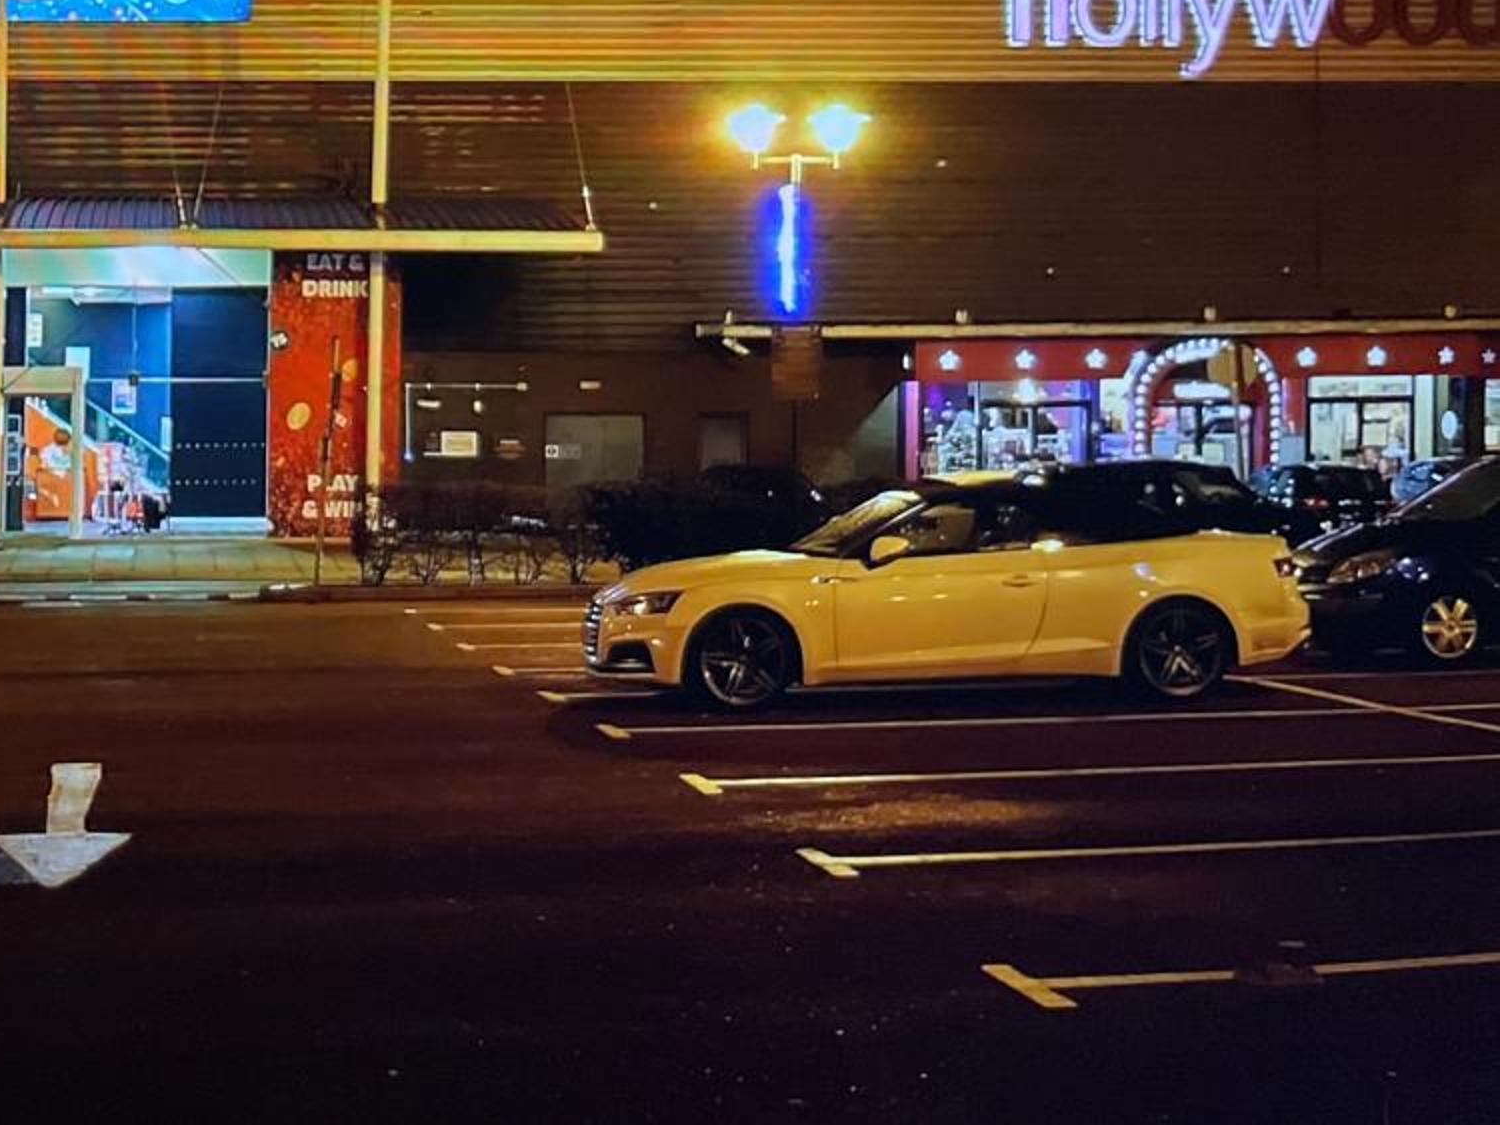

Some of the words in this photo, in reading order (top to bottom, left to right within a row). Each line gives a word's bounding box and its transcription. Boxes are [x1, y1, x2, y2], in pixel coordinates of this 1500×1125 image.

[306, 253, 345, 271] EAT
[347, 254, 365, 271] &
[301, 279, 369, 298] DRINK
[301, 500, 319, 519] &
